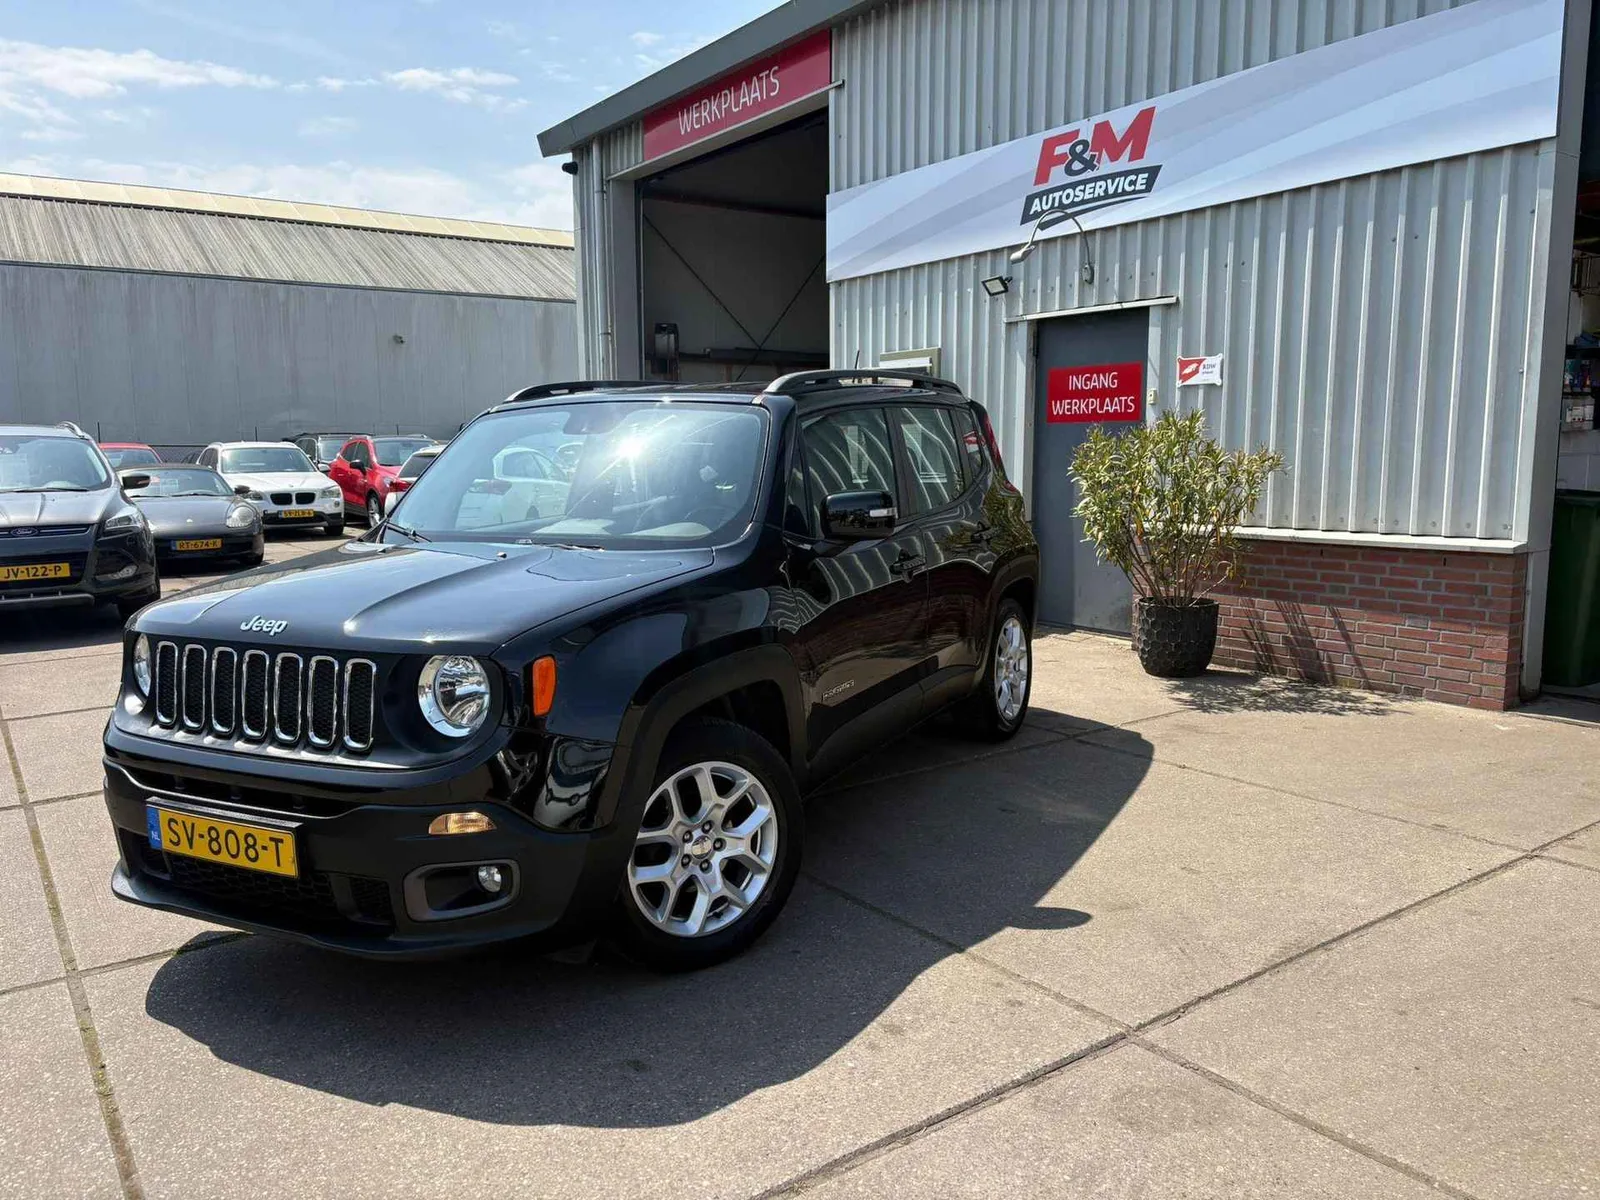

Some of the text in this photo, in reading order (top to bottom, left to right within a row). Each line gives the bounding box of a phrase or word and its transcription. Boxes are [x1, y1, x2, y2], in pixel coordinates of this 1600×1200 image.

[678, 65, 780, 136] WERKPLAATS
[1033, 105, 1157, 187] F&M
[1029, 172, 1149, 215] AUTOSERVICE
[1068, 371, 1119, 391] INGANG
[1051, 396, 1136, 416] WERKPLAATS
[3, 564, 63, 580] JV-122-P
[240, 614, 288, 637] Jeep
[167, 817, 285, 868] SV-808-T
